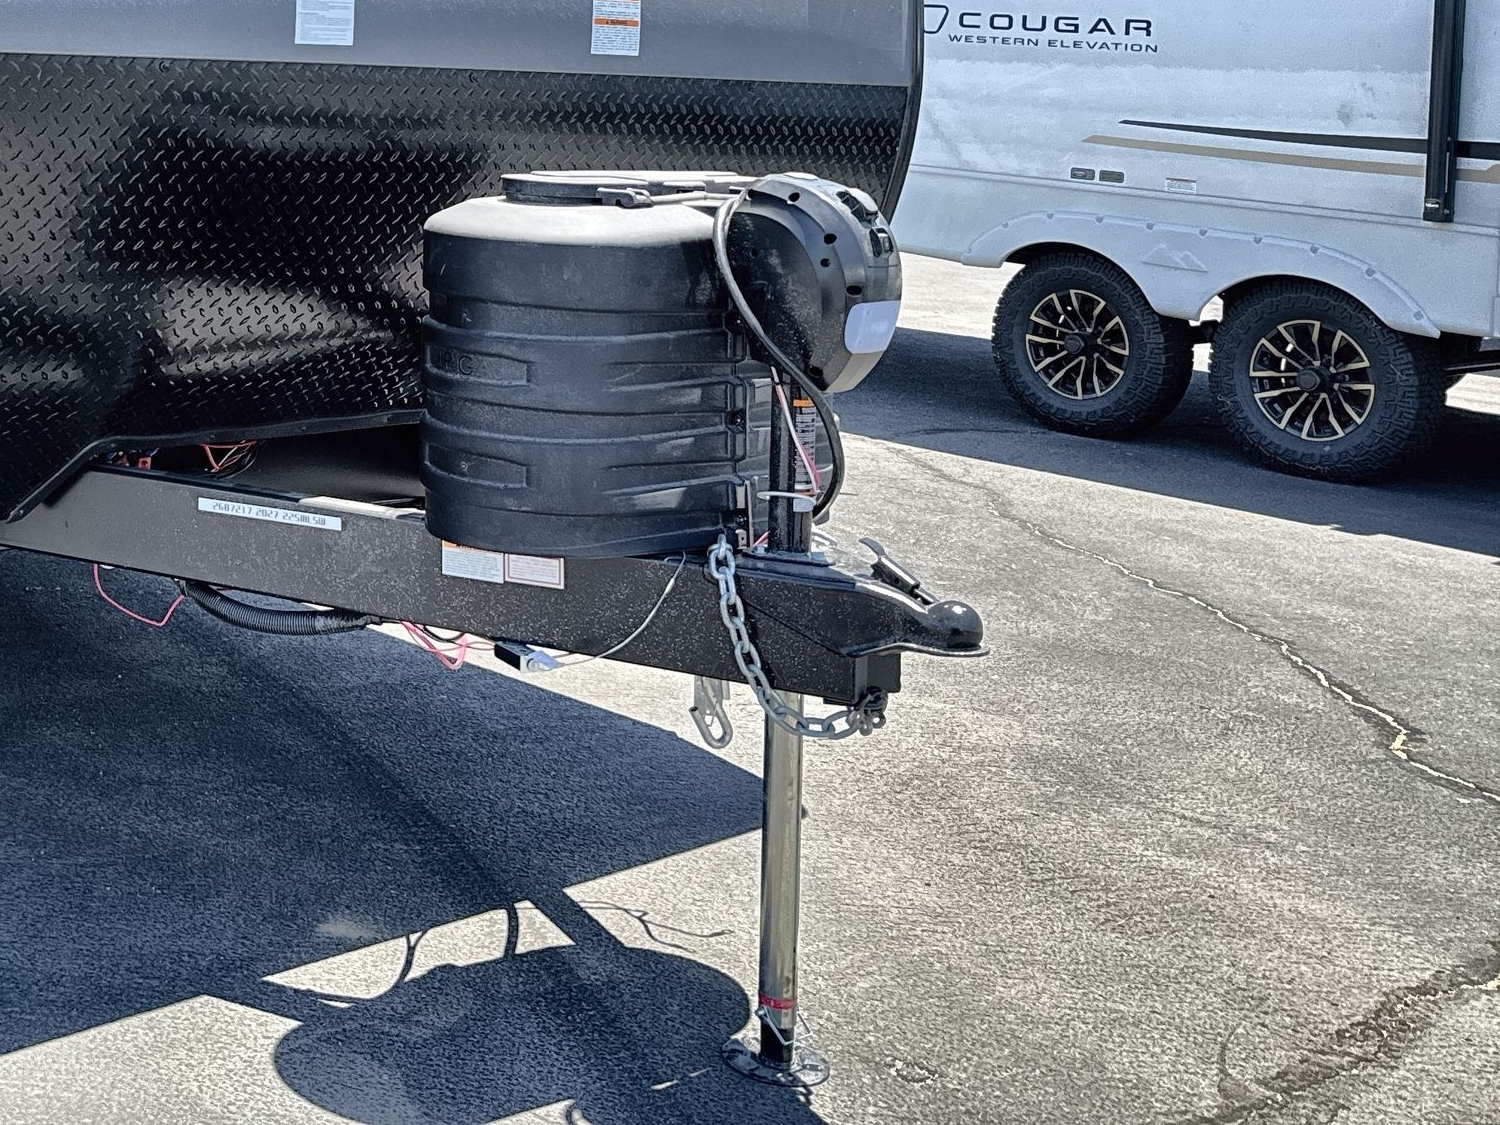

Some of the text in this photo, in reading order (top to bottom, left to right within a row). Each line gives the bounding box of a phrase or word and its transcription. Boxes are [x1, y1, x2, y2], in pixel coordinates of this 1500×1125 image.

[958, 12, 1153, 37] COUGAR
[948, 34, 1158, 53] WESTERN ELEVATION
[255, 508, 279, 519] 2027
